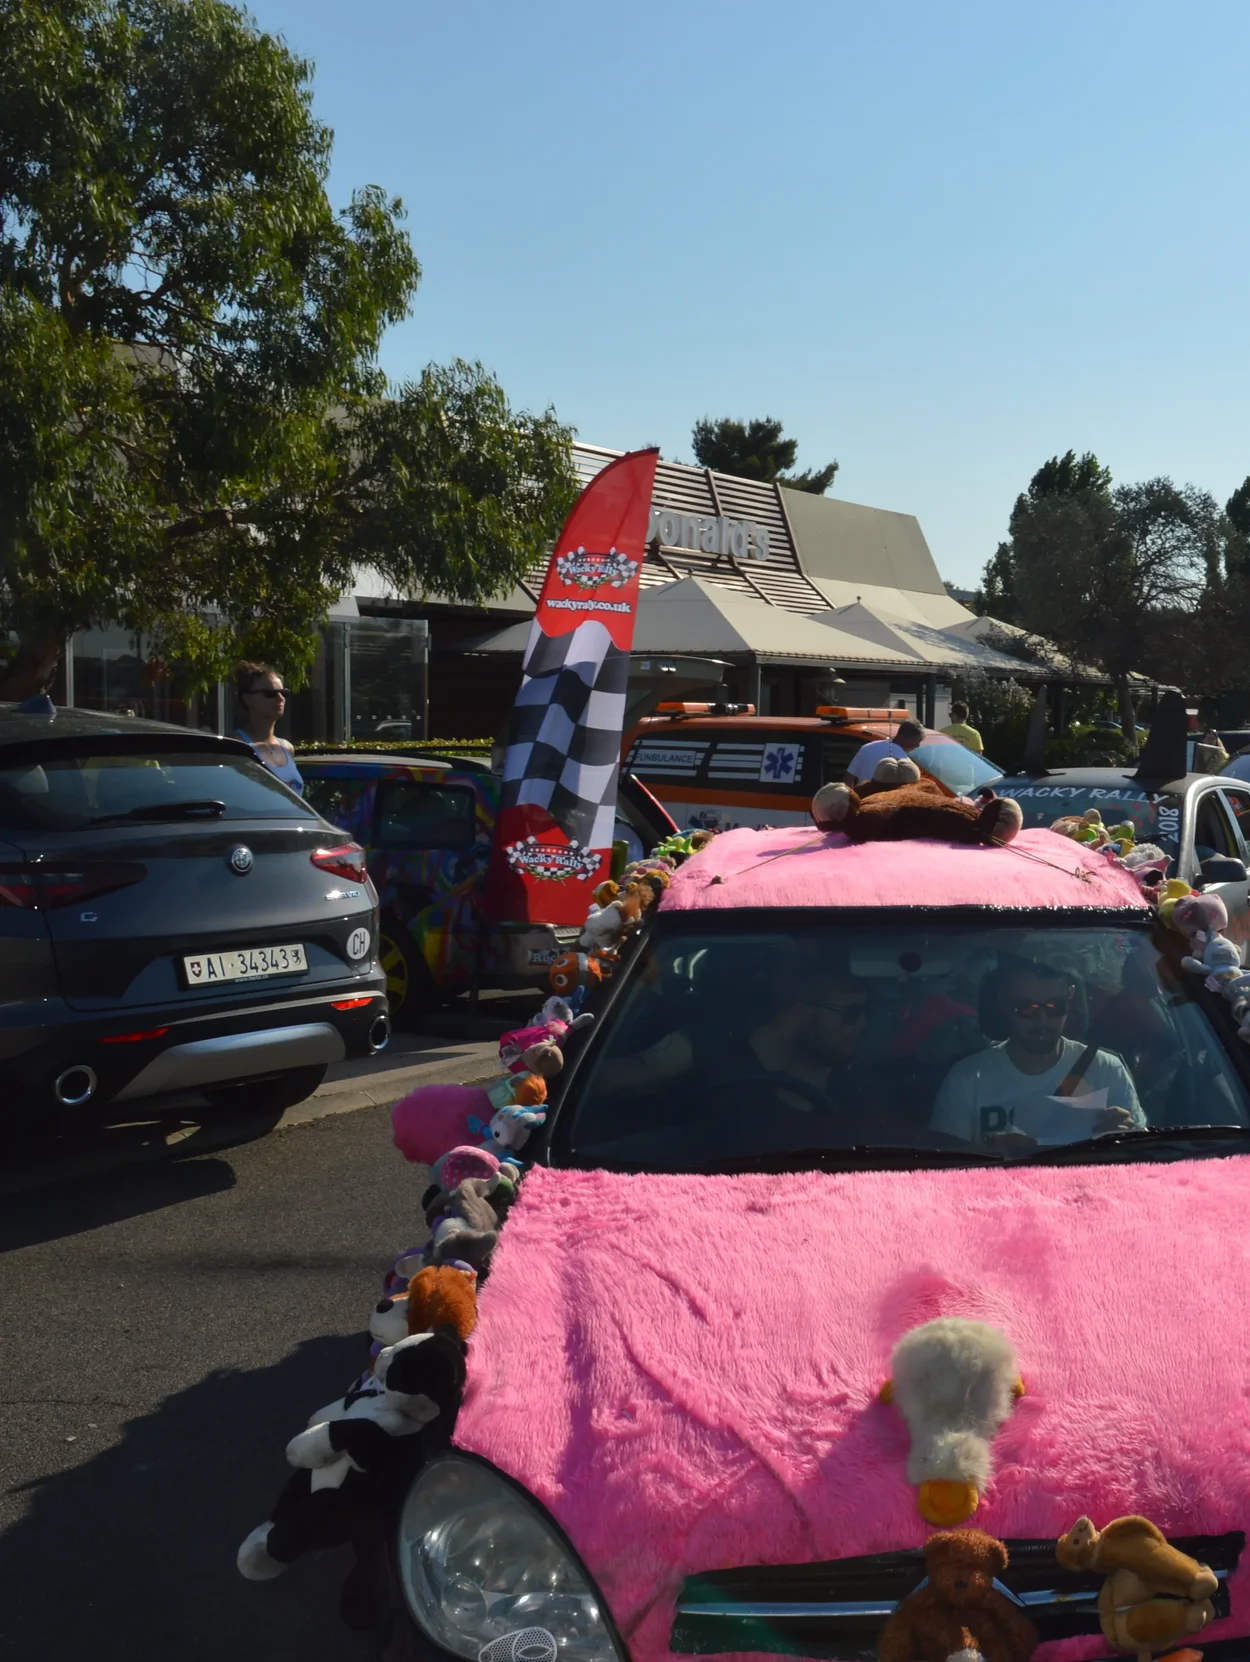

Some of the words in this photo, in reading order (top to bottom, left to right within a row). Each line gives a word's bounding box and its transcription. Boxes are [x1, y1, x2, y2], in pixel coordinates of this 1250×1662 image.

[1000, 787, 1085, 798] WACKY
[1089, 789, 1169, 804] RALLY
[1158, 806, 1179, 843] 2018
[520, 854, 553, 865] Wacky
[555, 856, 584, 870] Rally
[352, 931, 366, 955] CH
[237, 949, 290, 975] 34343
